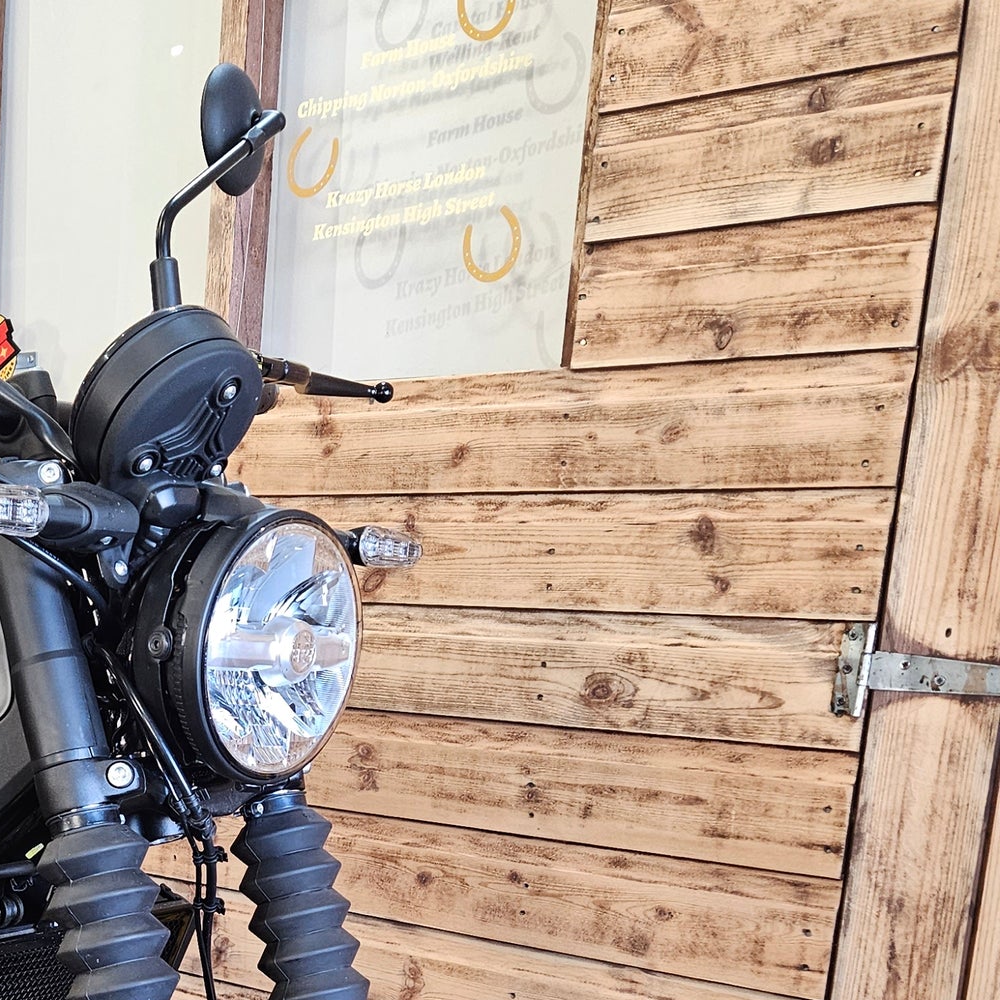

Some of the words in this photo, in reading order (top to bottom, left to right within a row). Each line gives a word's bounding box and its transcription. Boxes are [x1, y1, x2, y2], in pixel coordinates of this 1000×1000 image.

[360, 42, 405, 70] Farm
[407, 34, 457, 58] House
[297, 89, 367, 120] Chipping
[369, 52, 534, 102] Norton-Oxfordshire
[325, 184, 374, 209] Krazy
[375, 176, 421, 199] Horse
[423, 163, 486, 189] London
[312, 211, 401, 241] Kensington
[402, 202, 443, 225] High
[444, 191, 496, 216] Street
